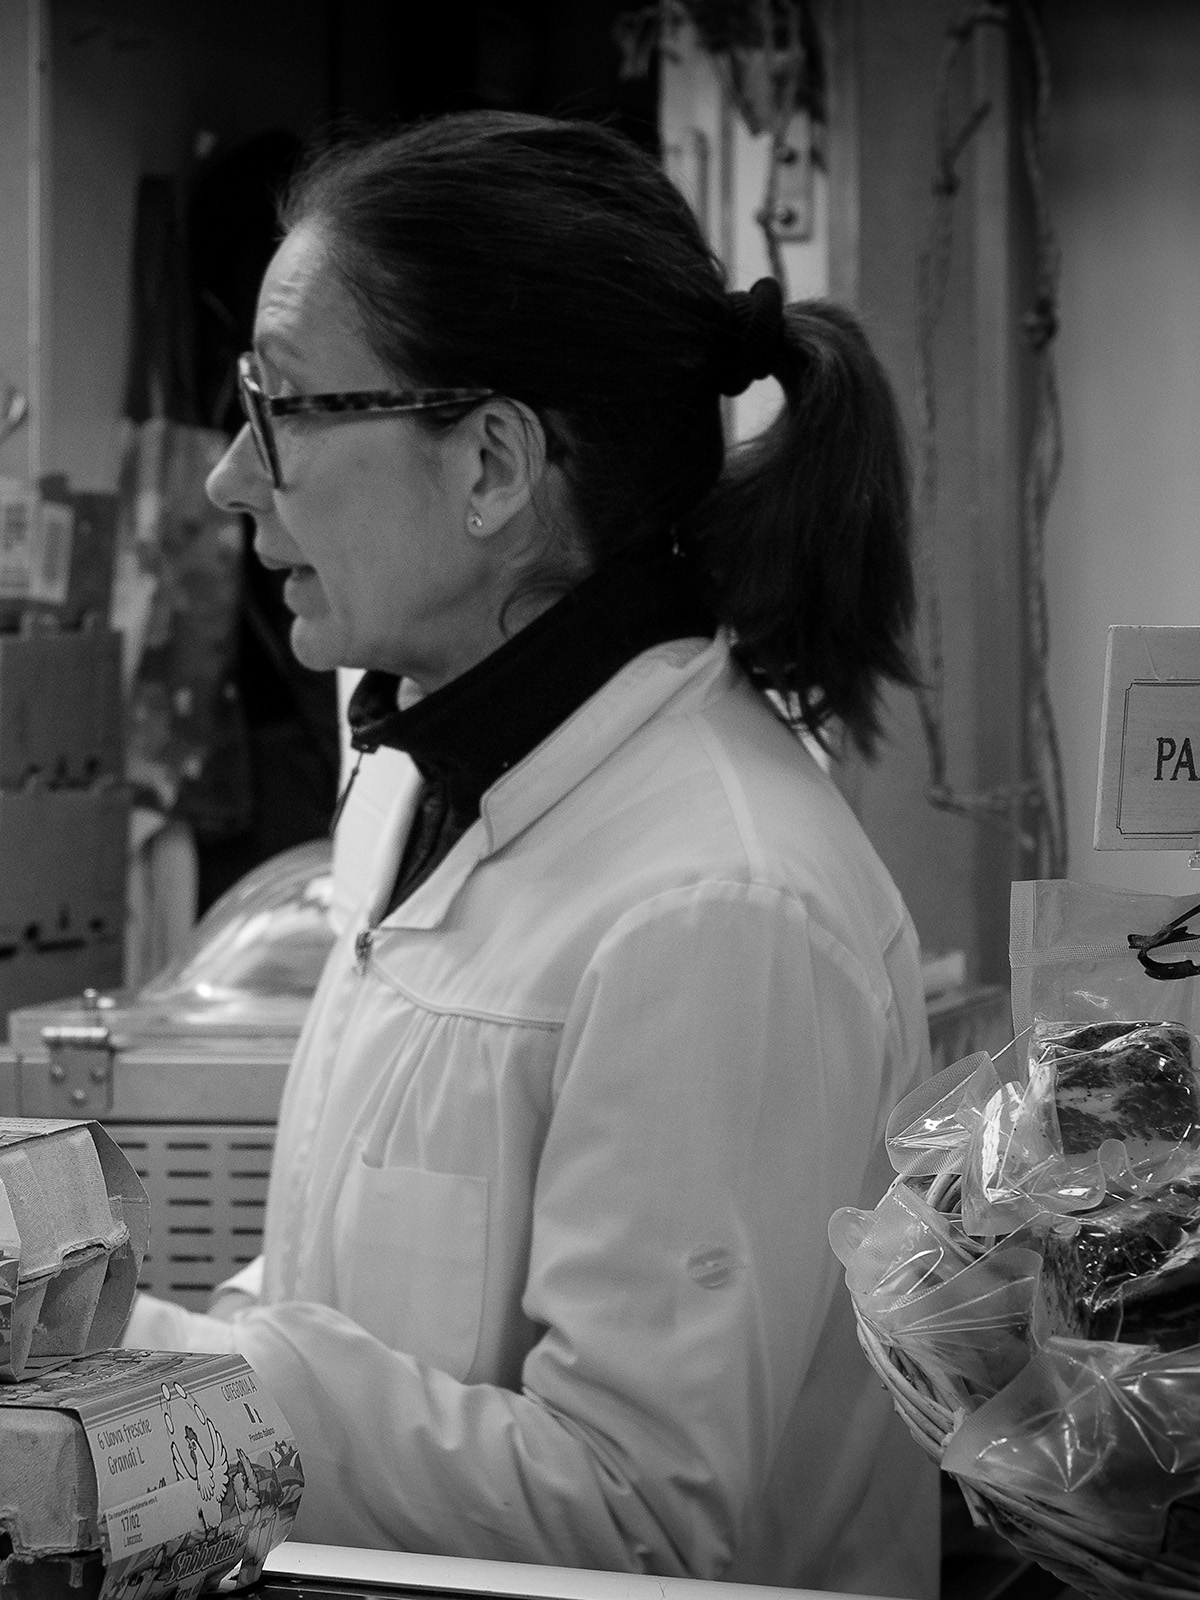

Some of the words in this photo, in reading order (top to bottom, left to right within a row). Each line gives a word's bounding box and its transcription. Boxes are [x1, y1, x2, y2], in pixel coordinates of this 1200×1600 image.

[97, 1432, 106, 1450] 6
[123, 1418, 153, 1443] fresche
[107, 1447, 139, 1475] Grandi
[136, 1446, 145, 1465] L
[121, 1513, 141, 1532] 17/02
